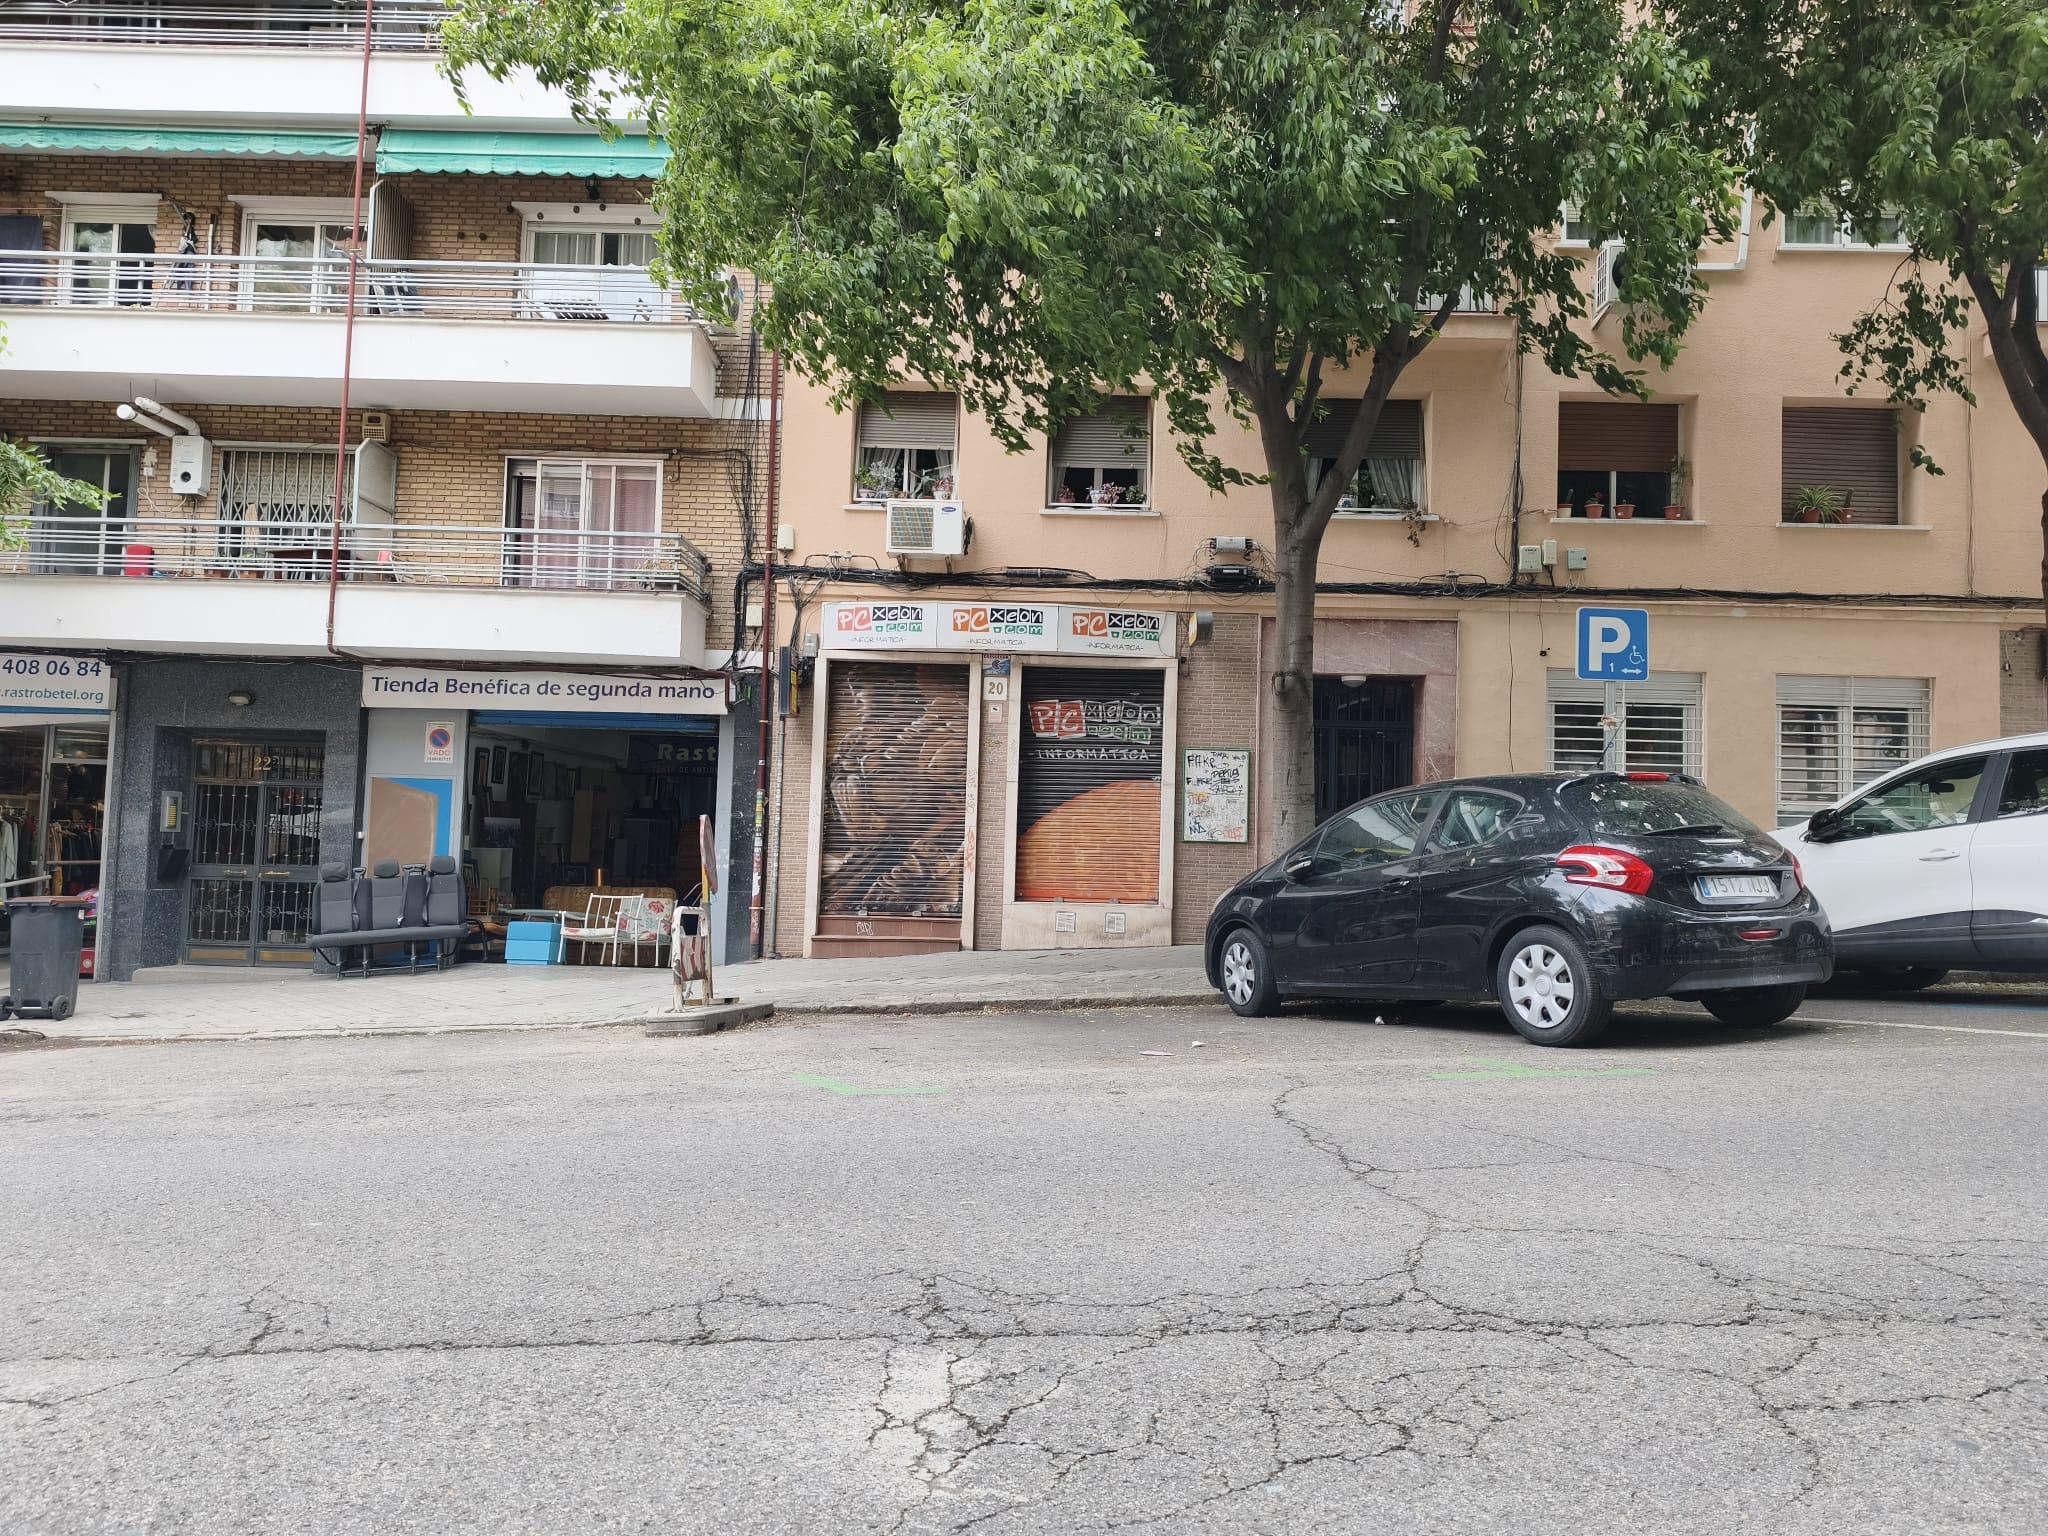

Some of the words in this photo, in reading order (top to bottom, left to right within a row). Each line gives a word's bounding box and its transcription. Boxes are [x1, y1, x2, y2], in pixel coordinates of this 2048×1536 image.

[838, 608, 871, 631] PC
[954, 608, 988, 632] PC
[1073, 613, 1107, 636] PC
[1589, 616, 1631, 671] P
[2, 659, 40, 675] 408
[46, 660, 70, 676] 06
[77, 661, 101, 677] 84
[1609, 662, 1614, 672] 1
[0, 688, 104, 704] .rastrobetel.org
[372, 677, 438, 693] Tienda
[445, 678, 530, 695] Benéfica
[536, 681, 560, 696] de
[566, 682, 652, 700] segunda
[658, 686, 715, 699] mano
[988, 681, 1003, 695] 20
[1031, 702, 1083, 736] PC
[253, 756, 272, 770] 22
